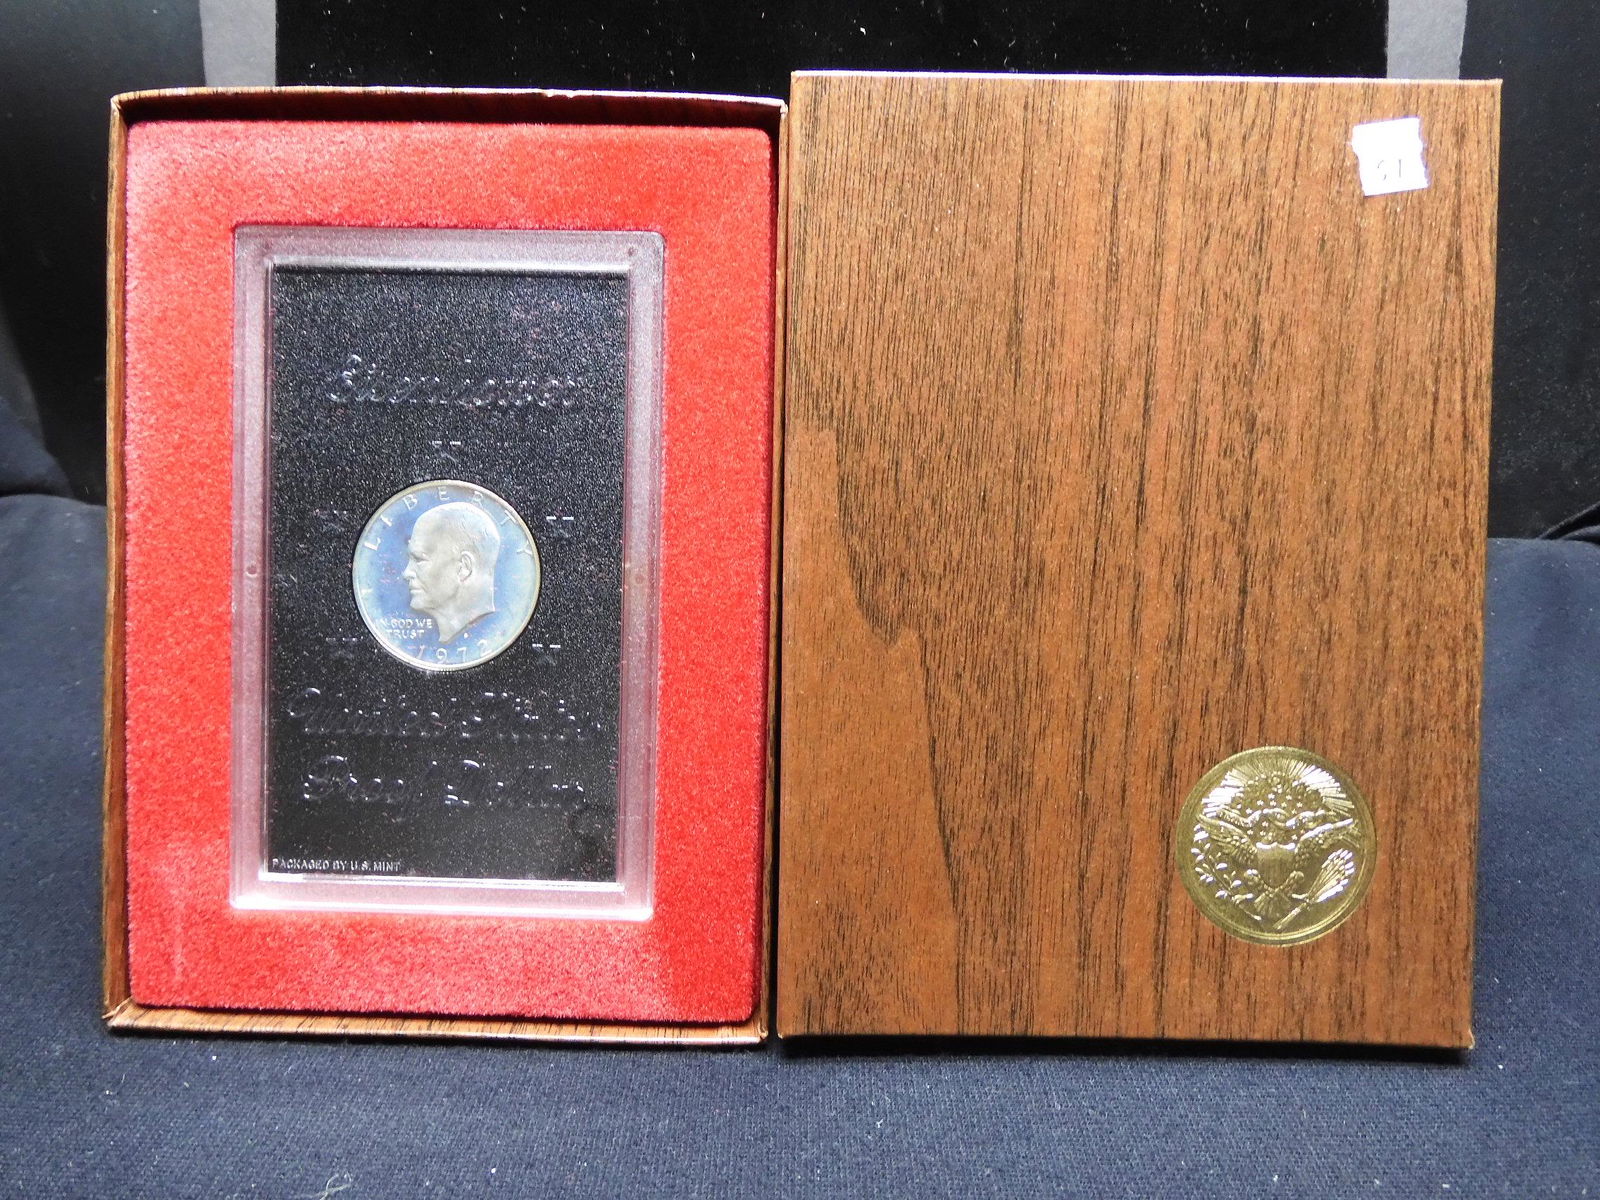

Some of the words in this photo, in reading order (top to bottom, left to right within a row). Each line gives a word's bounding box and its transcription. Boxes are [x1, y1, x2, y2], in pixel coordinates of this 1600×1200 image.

[364, 486, 532, 555] LIBERTY
[391, 618, 413, 629] GOD
[415, 618, 433, 629] WE
[386, 629, 425, 639] TRUST
[414, 640, 493, 663] 1972
[272, 858, 330, 871] PACKAGED
[333, 860, 347, 871] BY
[373, 861, 401, 872] MINT
